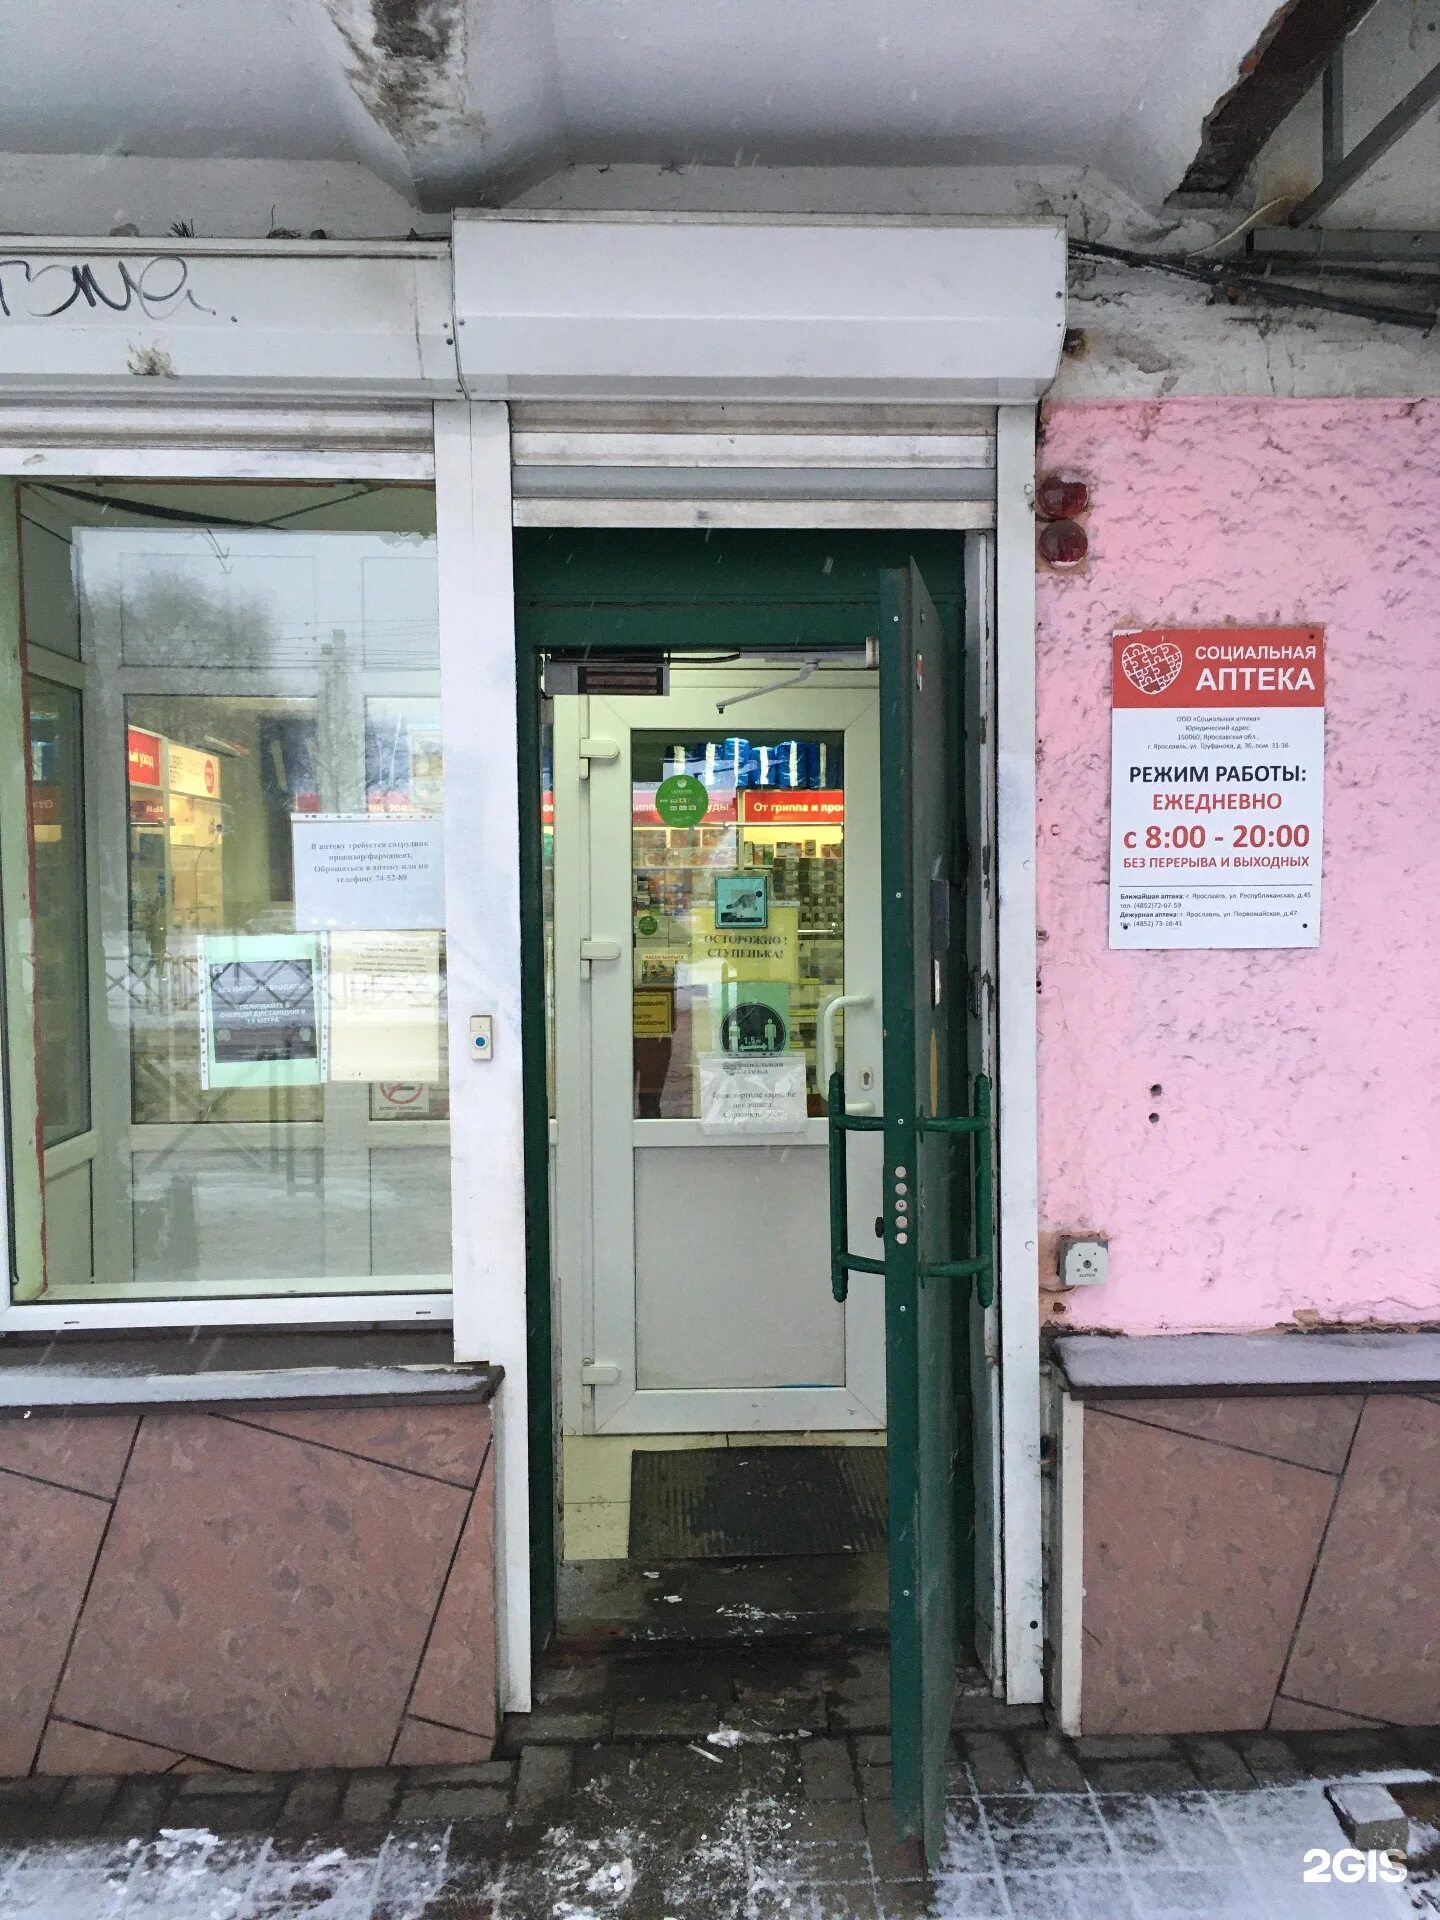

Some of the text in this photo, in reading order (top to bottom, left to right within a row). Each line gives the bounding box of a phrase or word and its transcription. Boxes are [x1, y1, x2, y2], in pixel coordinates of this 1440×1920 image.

[1195, 646, 1316, 661] СОЦИАЛЬНАЯ
[1195, 667, 1315, 691] АПТЕКА
[1130, 765, 1306, 783] РЕЖИМ РАБОТЫ:
[753, 802, 768, 812] От
[771, 803, 809, 815] гриппа
[811, 804, 819, 812] и
[1152, 793, 1282, 813] ЕЖЕДНЕВНО
[1145, 825, 1206, 849] 8:00
[1233, 824, 1310, 847] 20:00
[349, 842, 386, 851] требуется
[1123, 856, 1309, 869] БЕЗ ПЕРЕРЫВА И ВЫХОДНЫХ
[1120, 911, 1154, 919] Дежурная
[704, 934, 781, 945] ОСТОРОЖНО
[707, 948, 784, 959] СТУПЕНЬКА!
